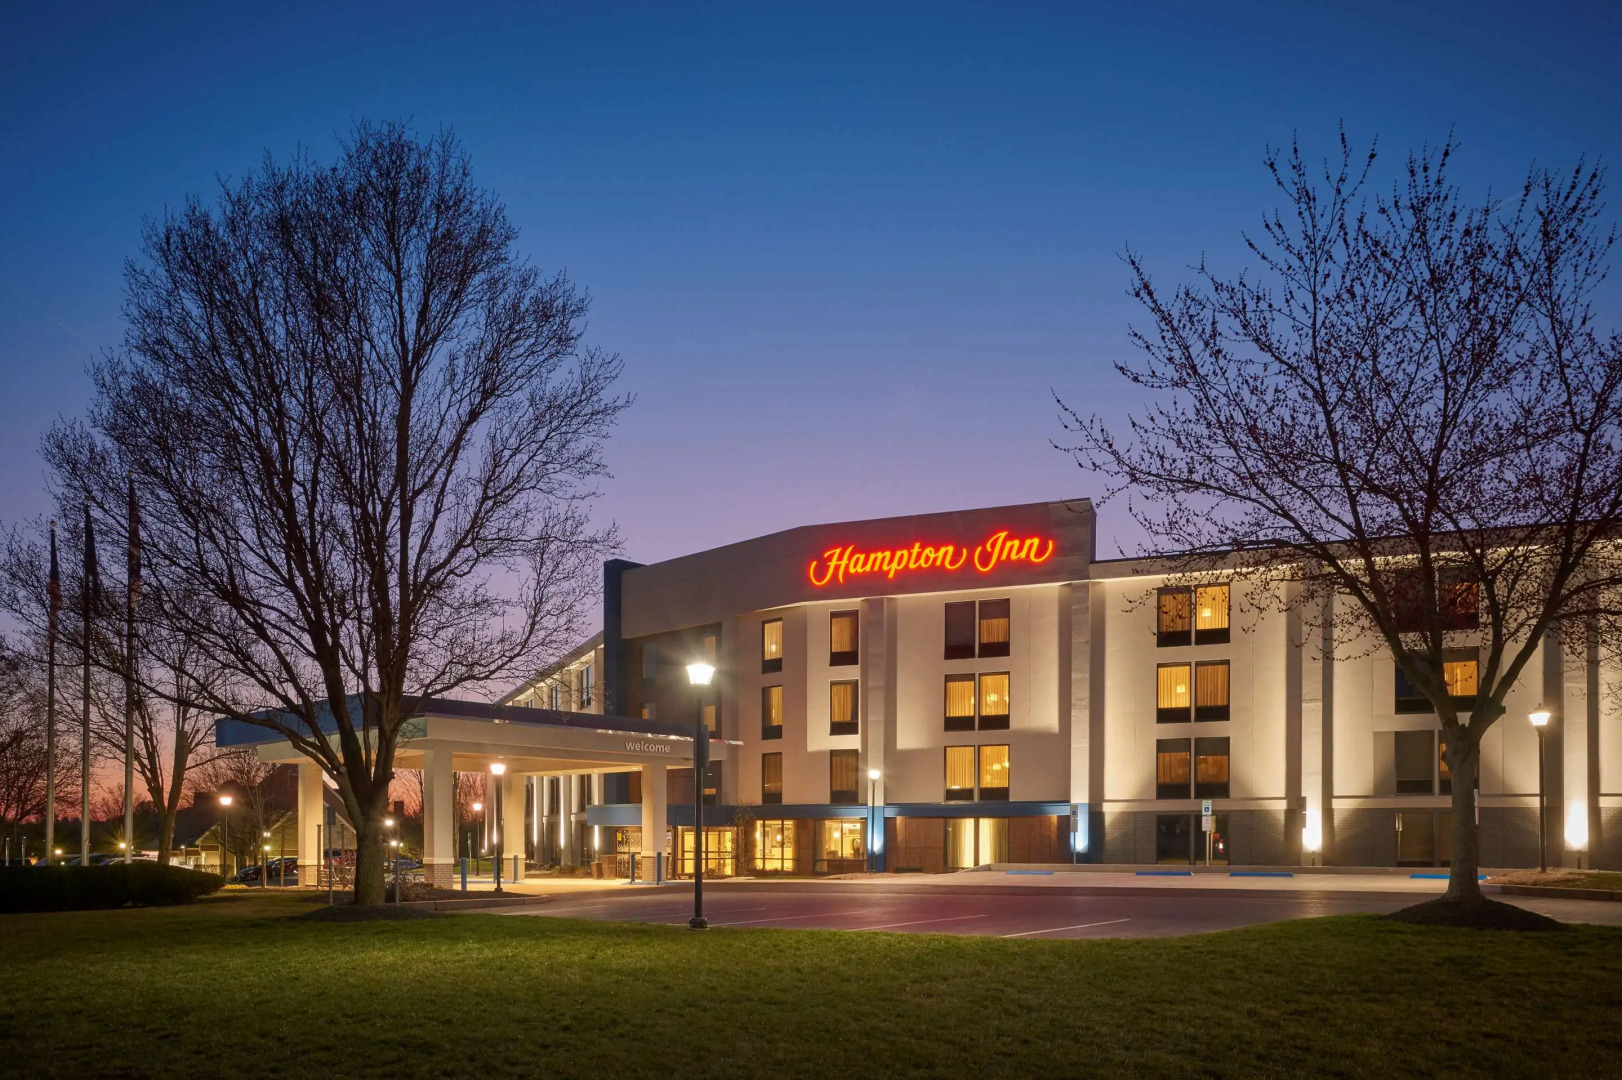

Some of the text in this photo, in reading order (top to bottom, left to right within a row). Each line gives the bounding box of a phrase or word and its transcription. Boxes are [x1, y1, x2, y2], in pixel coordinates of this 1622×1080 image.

[809, 530, 1053, 585] Hampton Inn
[625, 740, 671, 753] welcome
